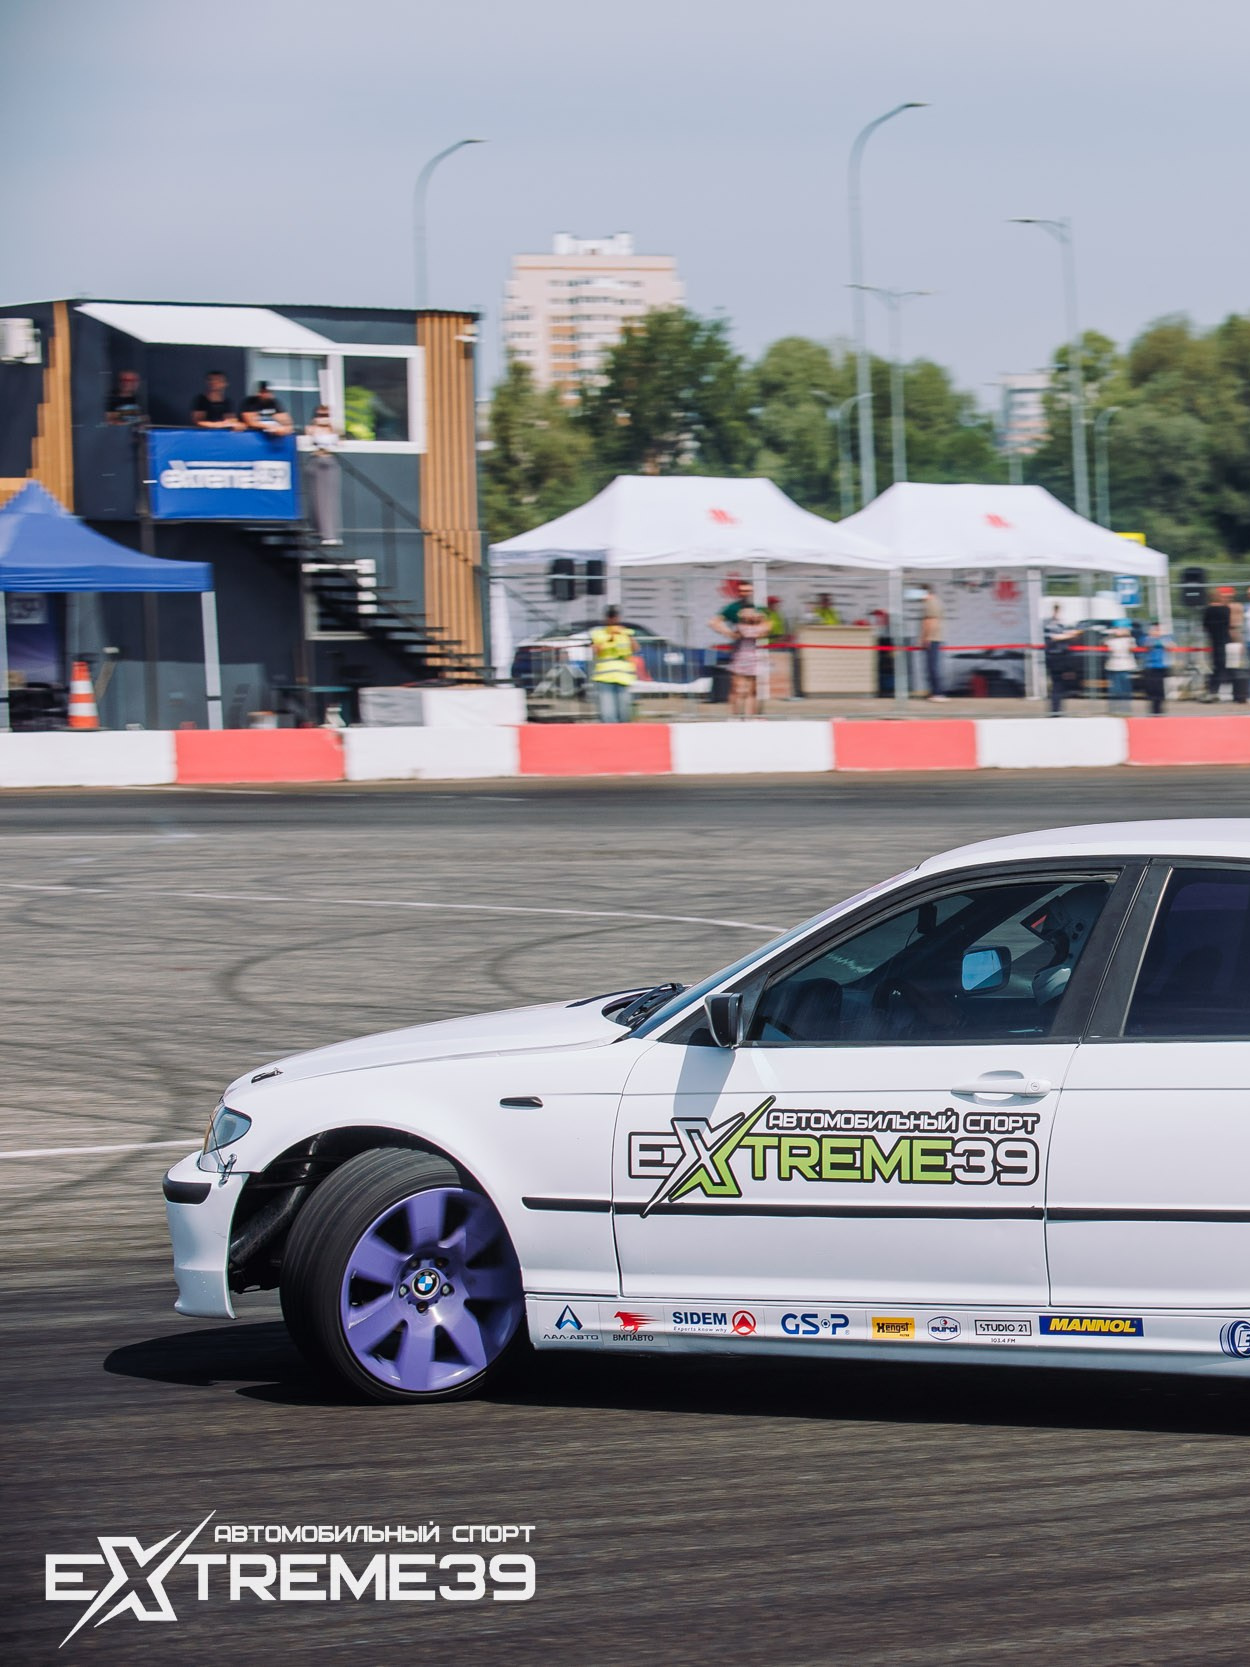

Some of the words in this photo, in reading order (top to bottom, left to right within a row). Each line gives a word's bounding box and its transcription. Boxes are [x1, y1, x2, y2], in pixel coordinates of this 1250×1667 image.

[767, 1108, 958, 1134] АВТОМОБИЛЬНЫЙ
[964, 1114, 1039, 1133] СПОРТ
[629, 1096, 1040, 1217] EXTREME39
[672, 1311, 727, 1325] SIDEM
[876, 1322, 909, 1334] Hengst
[930, 1323, 958, 1333] eurol
[979, 1323, 1015, 1332] STUDIO
[1018, 1323, 1028, 1333] 21
[1049, 1317, 1137, 1333] MANNOL
[612, 1334, 654, 1342] ВМПАВТО
